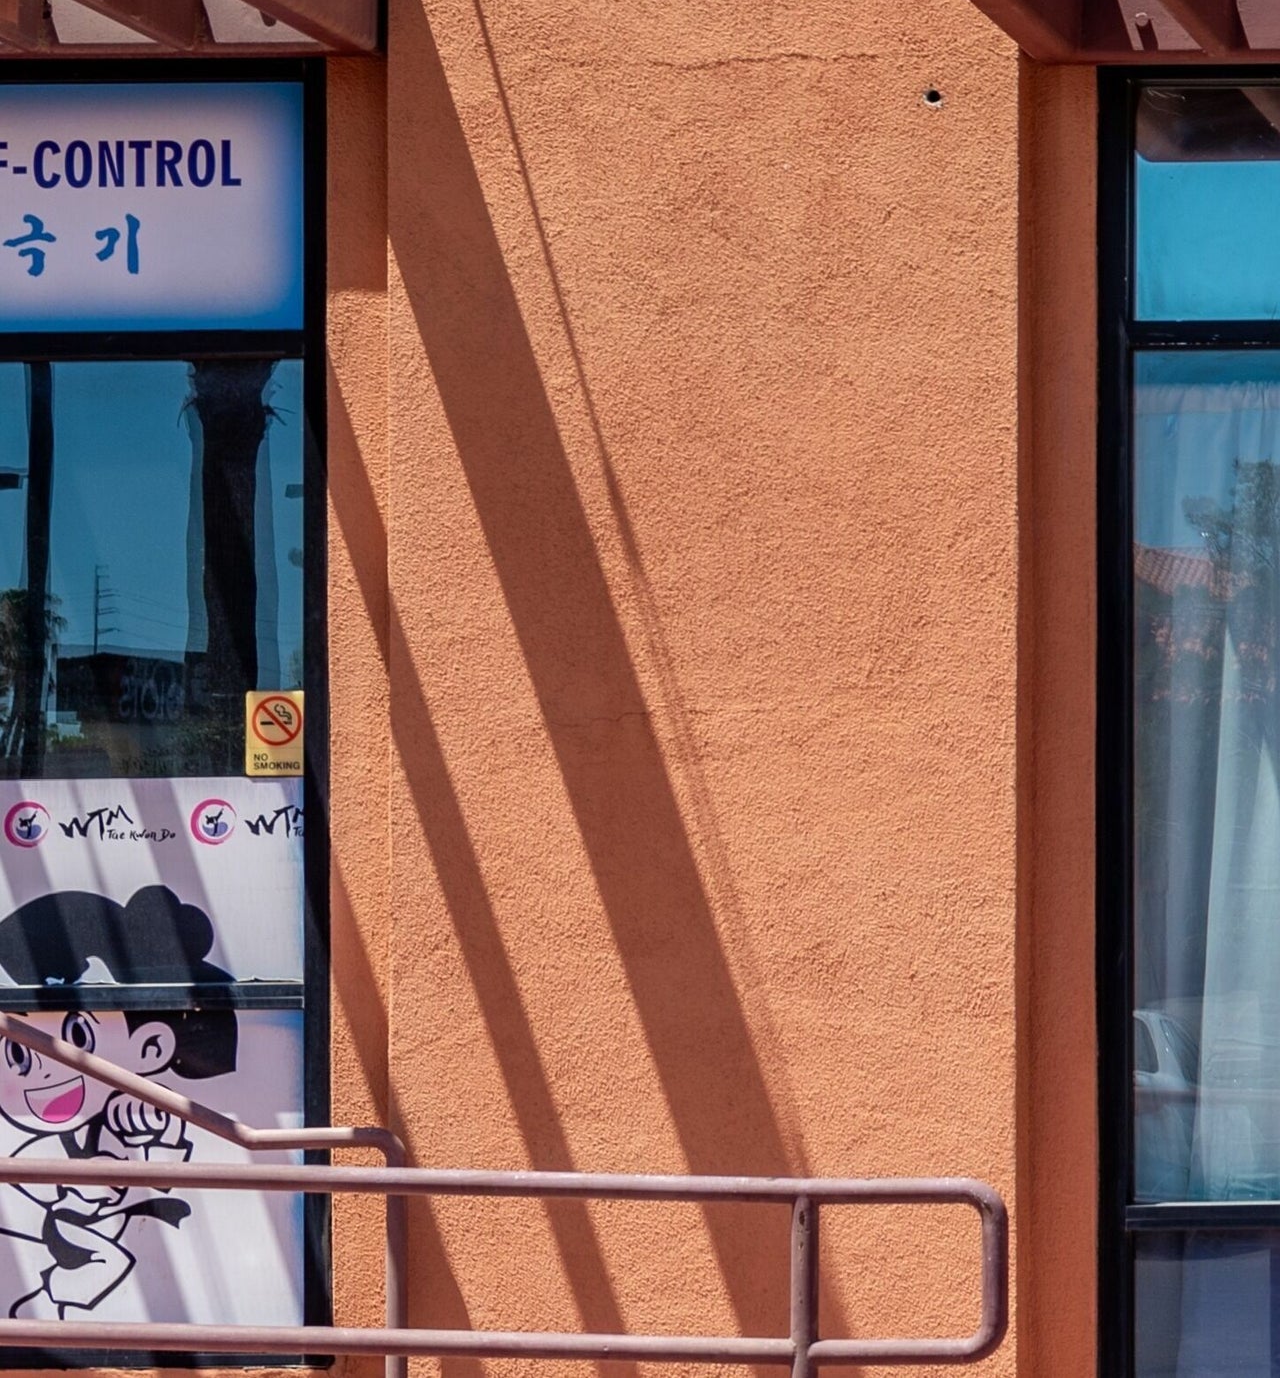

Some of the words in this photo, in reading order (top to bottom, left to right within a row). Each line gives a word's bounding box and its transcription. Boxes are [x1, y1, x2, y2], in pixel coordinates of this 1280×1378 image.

[254, 753, 268, 761] NO
[253, 761, 300, 770] SMOKING
[107, 828, 125, 840] Tae
[129, 828, 156, 842] Kwon
[159, 828, 176, 842] Do
